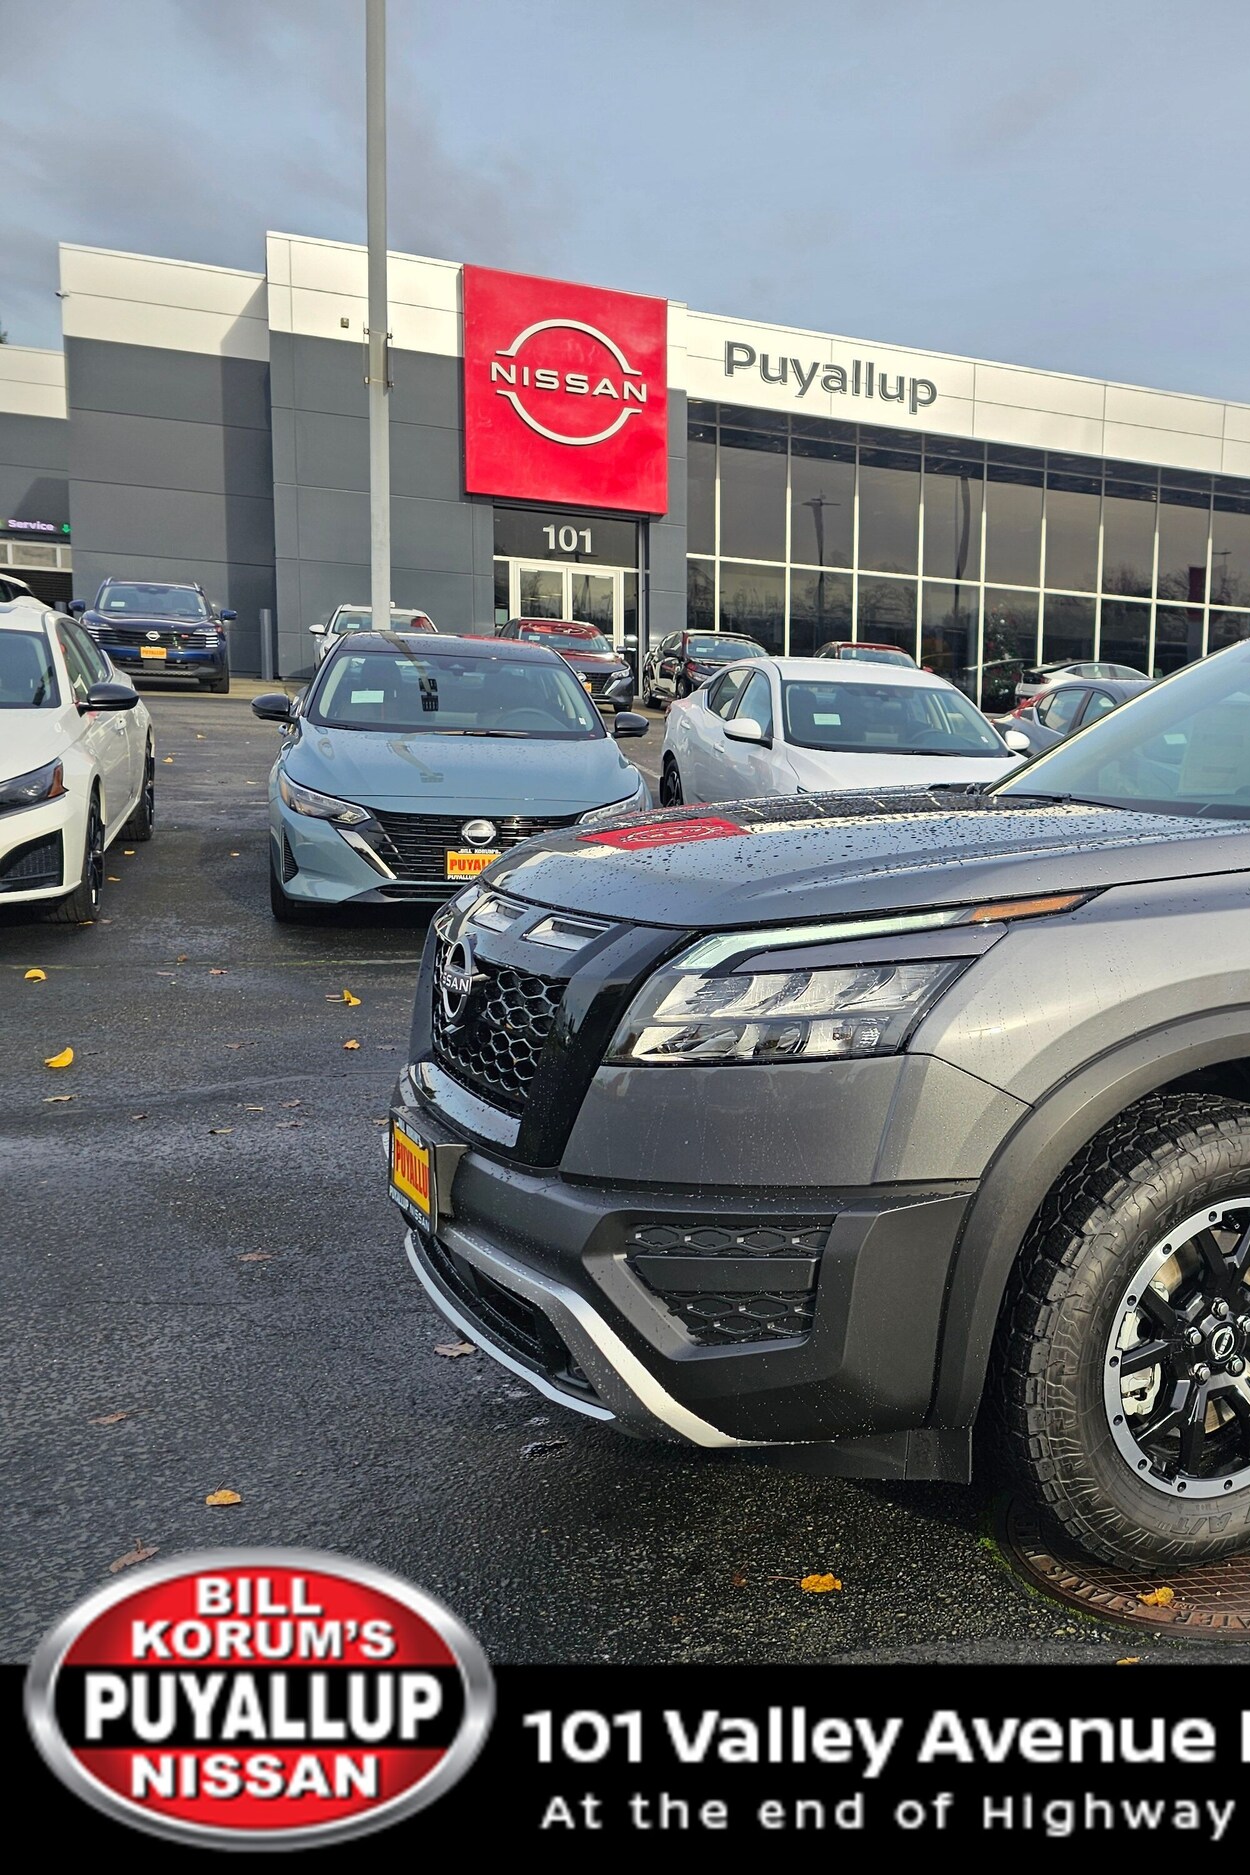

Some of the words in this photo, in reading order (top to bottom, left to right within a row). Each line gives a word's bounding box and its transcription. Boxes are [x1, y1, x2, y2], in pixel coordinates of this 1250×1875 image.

[491, 361, 647, 403] NISSAN
[725, 340, 938, 415] Puyallup
[8, 519, 54, 531] Service
[542, 524, 592, 553] 101
[442, 971, 470, 992] SSAN
[395, 1138, 429, 1199] PUYALLU
[1046, 1565, 1141, 1612] STARTS
